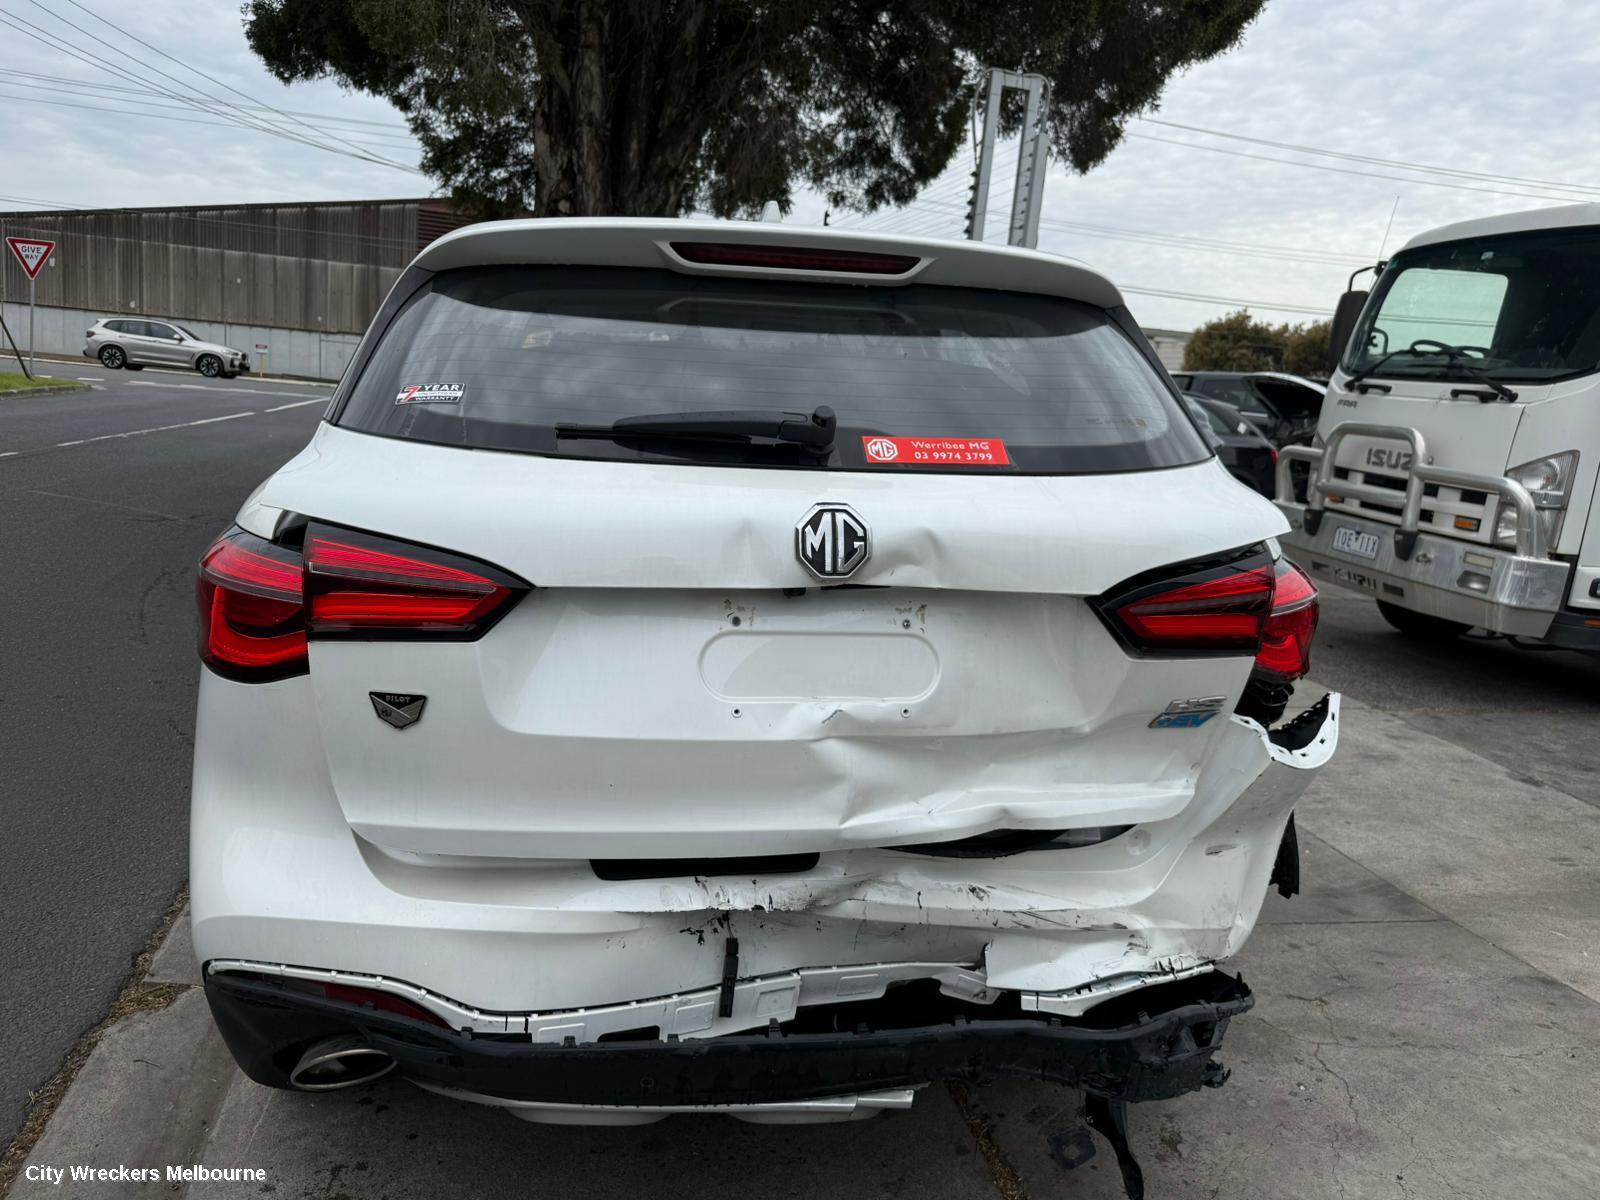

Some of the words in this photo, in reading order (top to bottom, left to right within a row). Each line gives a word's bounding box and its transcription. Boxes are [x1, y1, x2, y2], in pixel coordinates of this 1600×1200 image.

[21, 245, 42, 254] GIVE
[400, 385, 421, 402] 7
[869, 440, 896, 458] MG
[911, 441, 965, 450] Werribee
[969, 442, 990, 450] MG
[914, 451, 928, 459] 03
[932, 452, 960, 460] 9974
[964, 452, 993, 460] 3799
[1366, 447, 1434, 471] ISUZ
[801, 508, 868, 577] MG
[386, 695, 410, 703] PILOT
